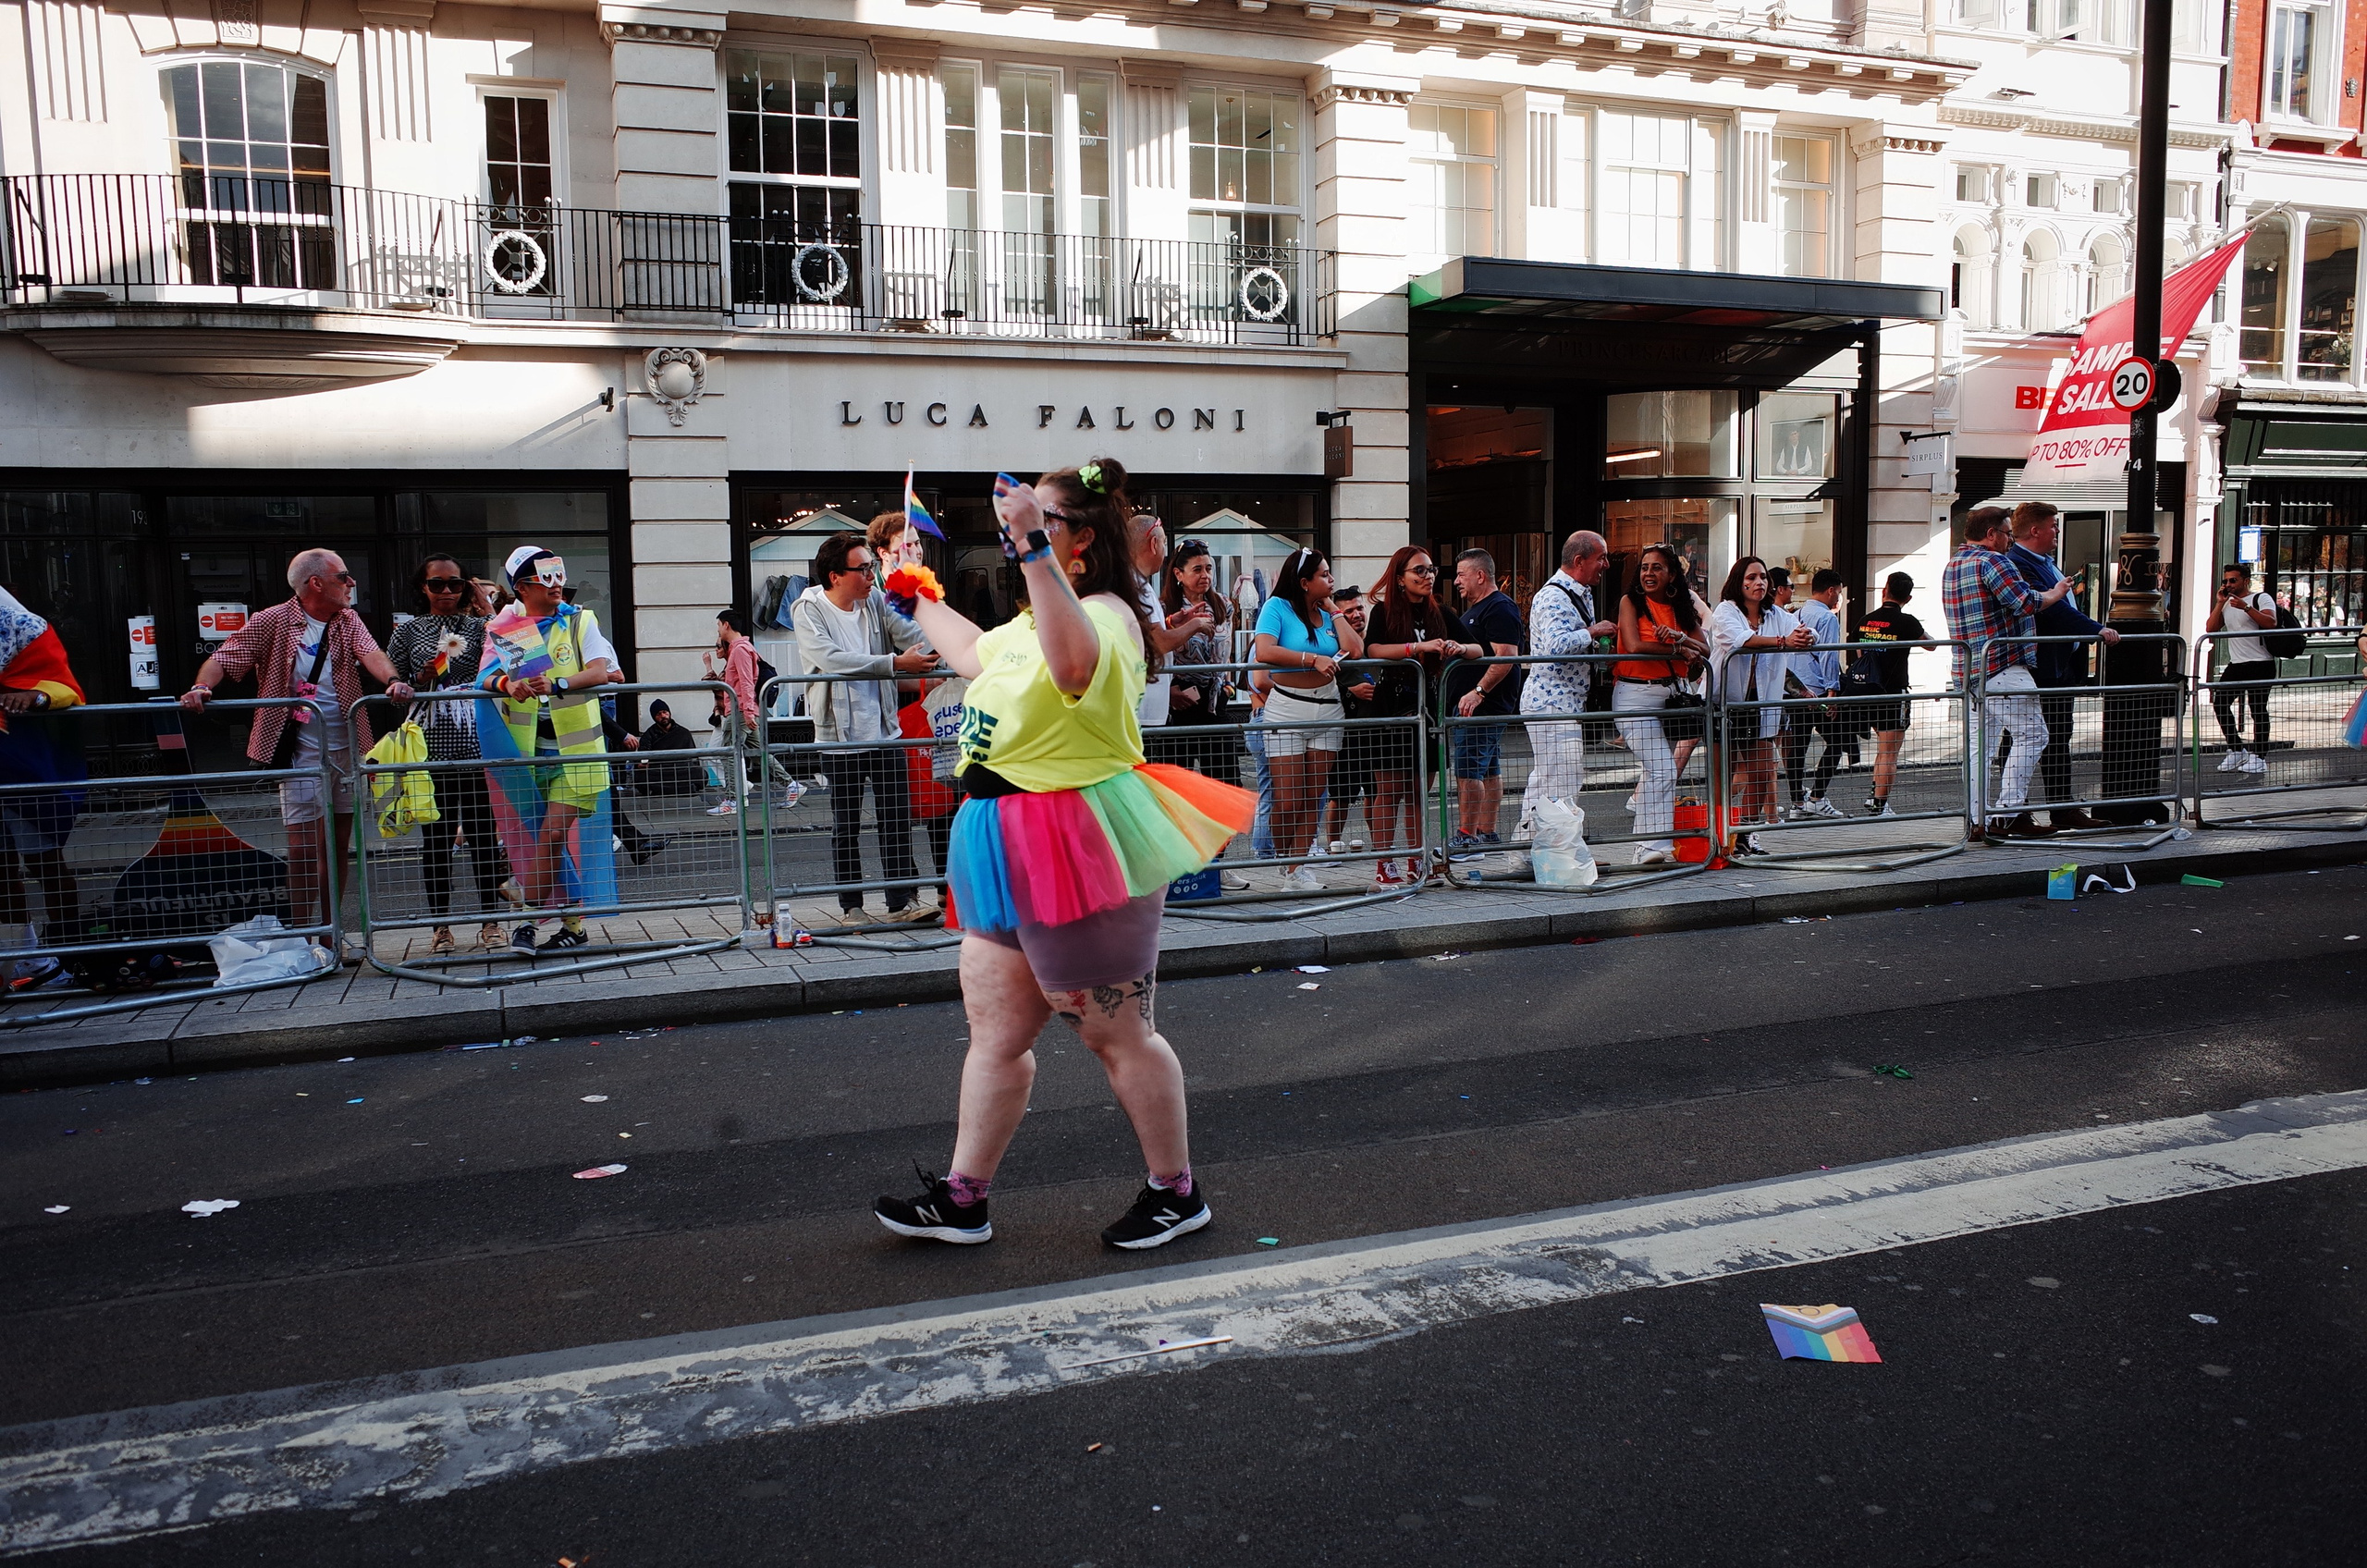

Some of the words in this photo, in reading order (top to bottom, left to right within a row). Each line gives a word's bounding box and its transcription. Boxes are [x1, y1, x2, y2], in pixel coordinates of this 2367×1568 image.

[2064, 337, 2175, 378] SAMPE
[2116, 372, 2148, 397] 20
[841, 401, 988, 426] LUCA
[1038, 405, 1245, 432] FALONI
[1911, 451, 1943, 462] SIRPLUS
[2040, 442, 2058, 461] TO
[2059, 439, 2094, 459] 80%
[2094, 437, 2130, 457] OFF
[496, 633, 519, 644] Raising
[505, 650, 523, 661] health
